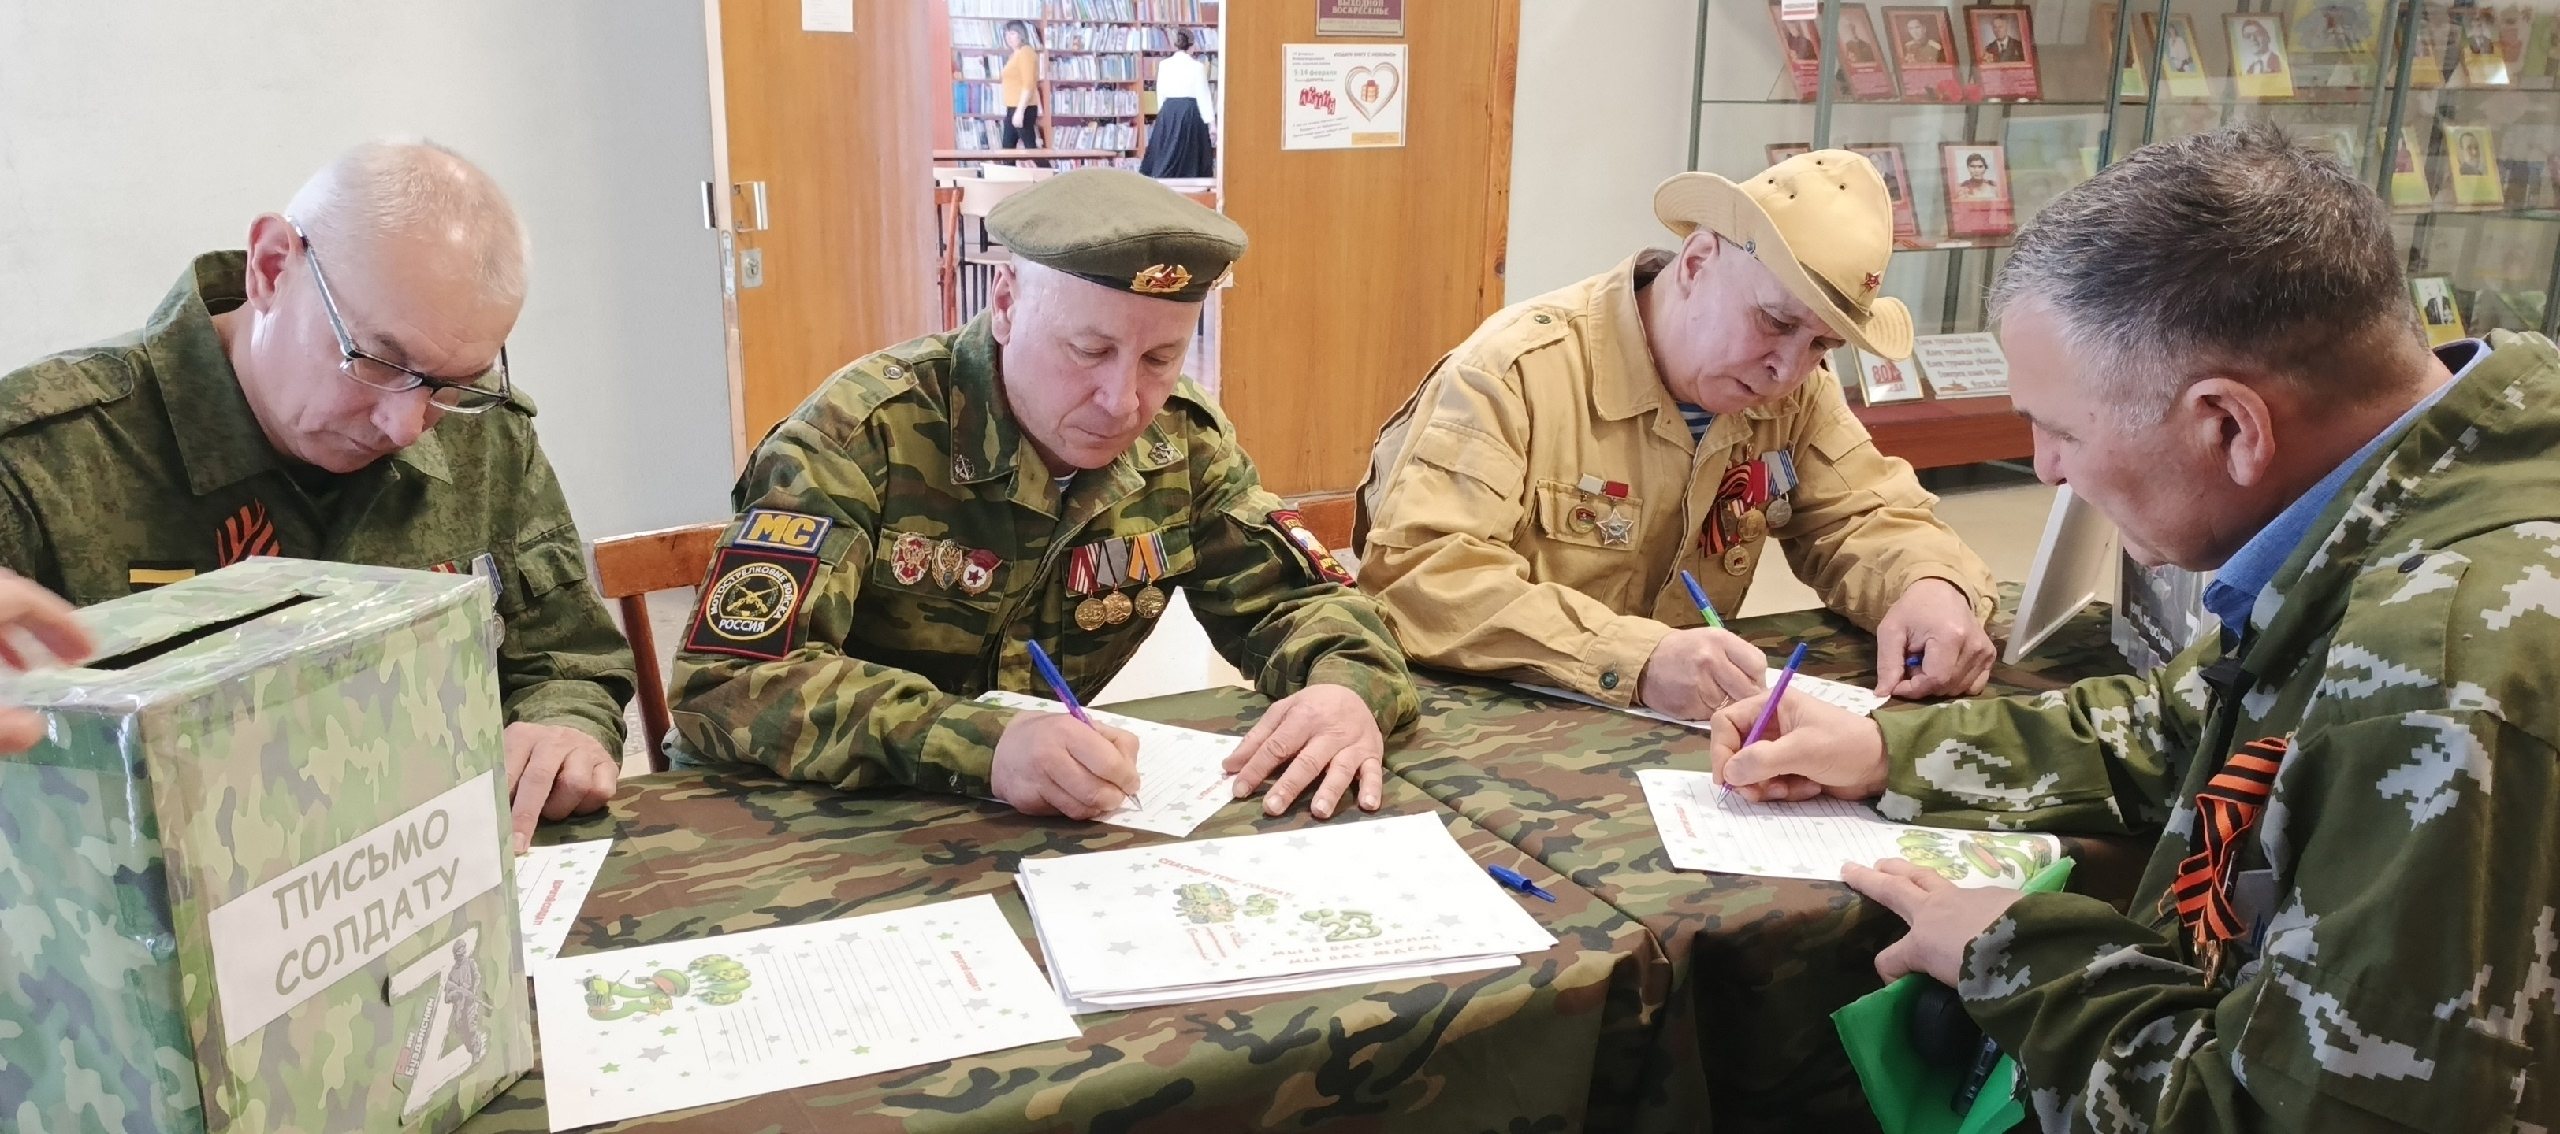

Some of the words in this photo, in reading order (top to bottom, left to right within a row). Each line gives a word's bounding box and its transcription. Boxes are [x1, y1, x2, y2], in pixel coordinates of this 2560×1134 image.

[747, 513, 816, 546] МС
[710, 566, 788, 615] МОТОСТРЕЛКОВЫЕ
[773, 582, 794, 618] ВОЙСКА
[719, 618, 766, 633] РОССИЯ
[272, 809, 449, 930] ПИСЬМО
[275, 857, 460, 996] СОЛДАТУ
